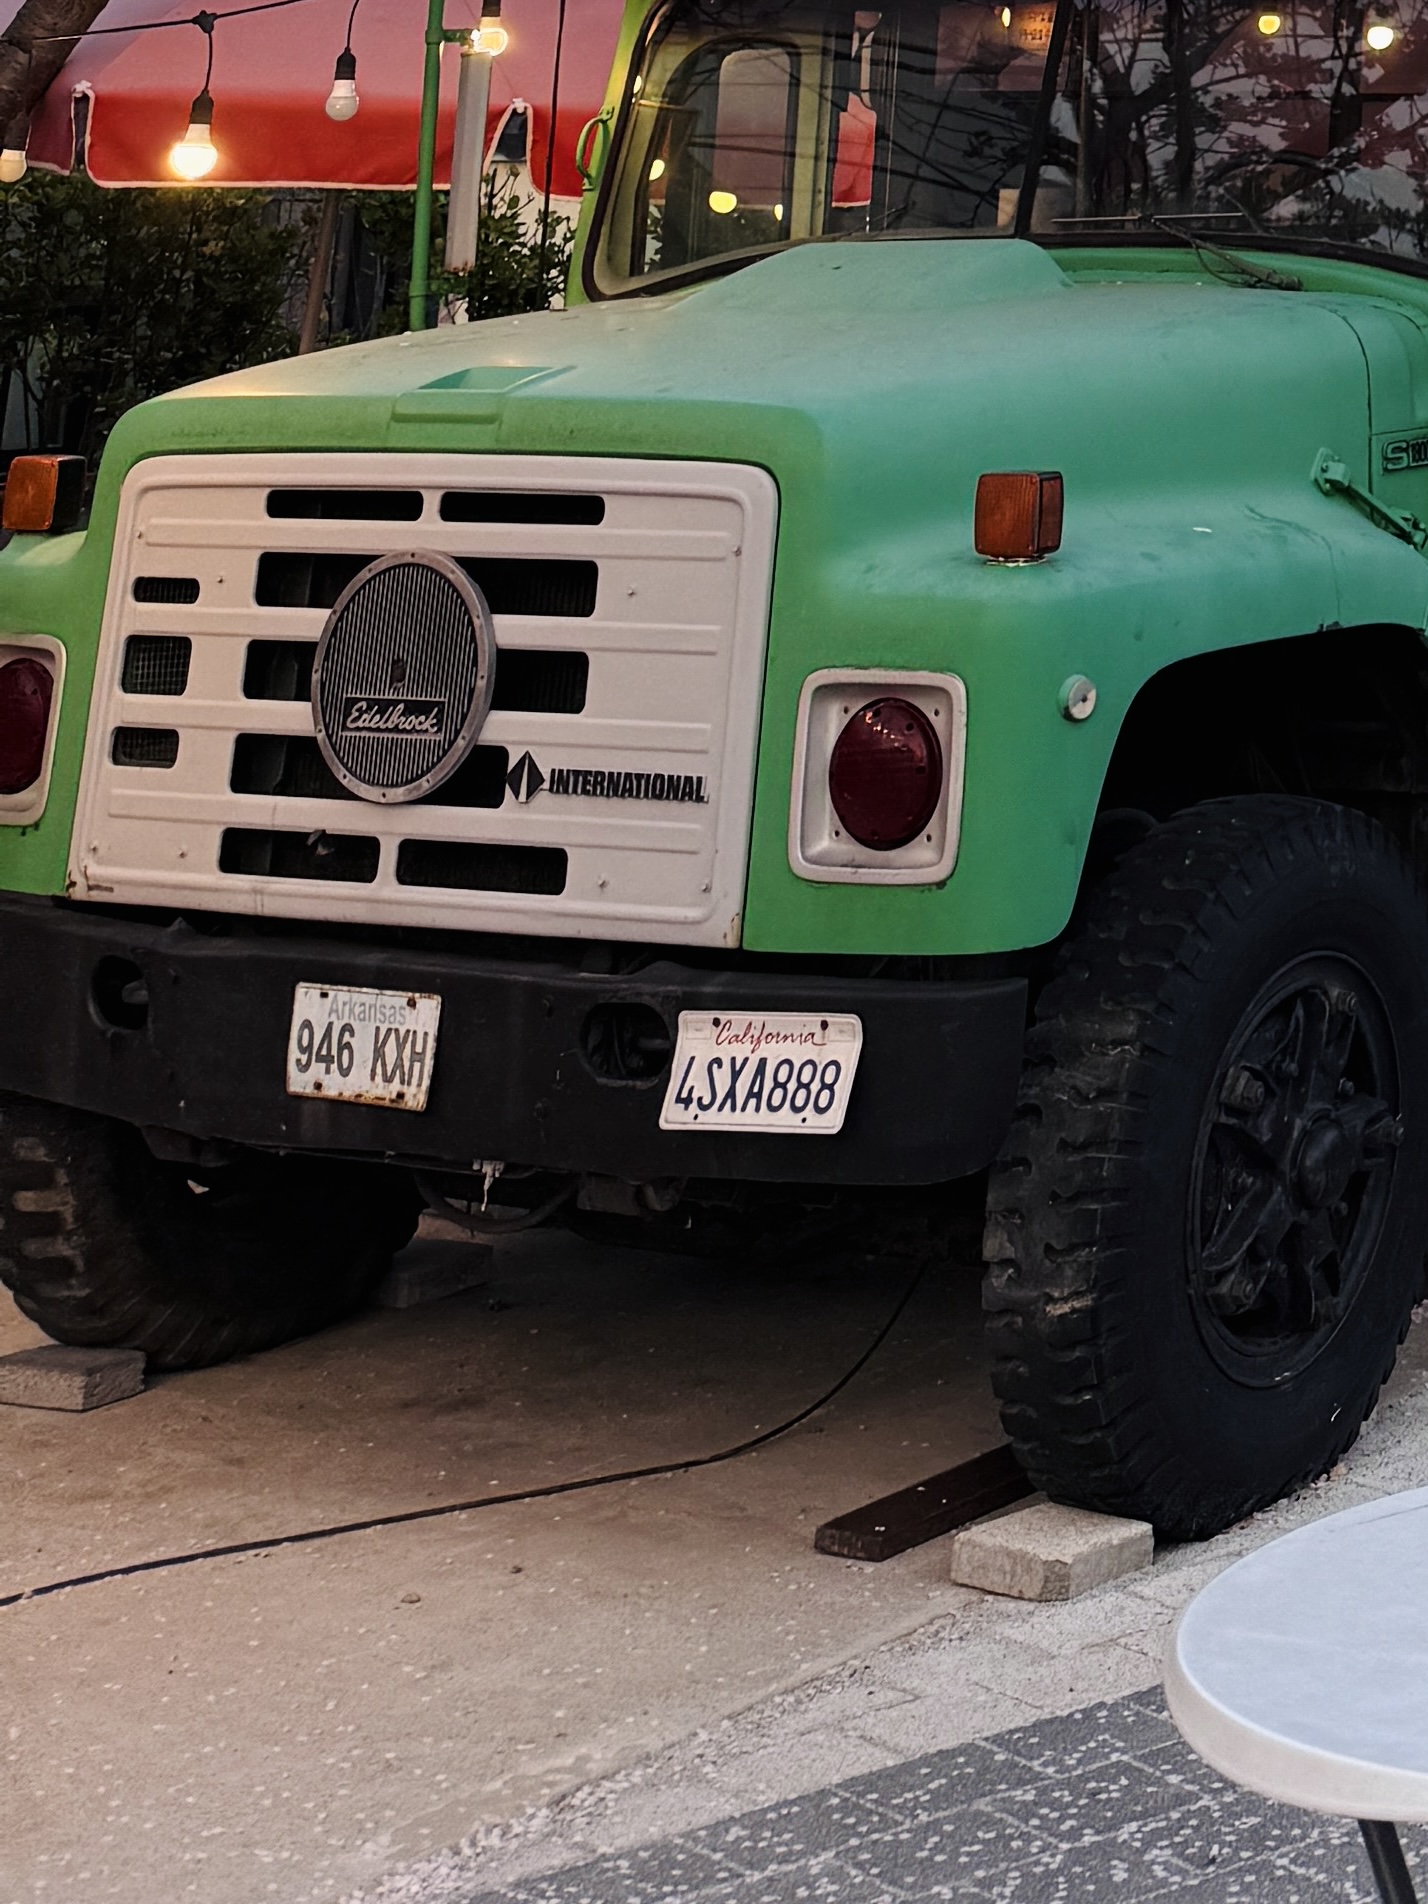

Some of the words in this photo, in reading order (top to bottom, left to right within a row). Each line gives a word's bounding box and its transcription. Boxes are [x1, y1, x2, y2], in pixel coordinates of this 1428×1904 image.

[346, 700, 439, 733] Edelbrock
[549, 768, 709, 804] INTERNATIONAL
[328, 994, 407, 1026] Arkansas
[295, 1018, 356, 1078] 946
[370, 1025, 429, 1088] KXH
[715, 1018, 827, 1054] California
[674, 1055, 842, 1115] 4SXA888
